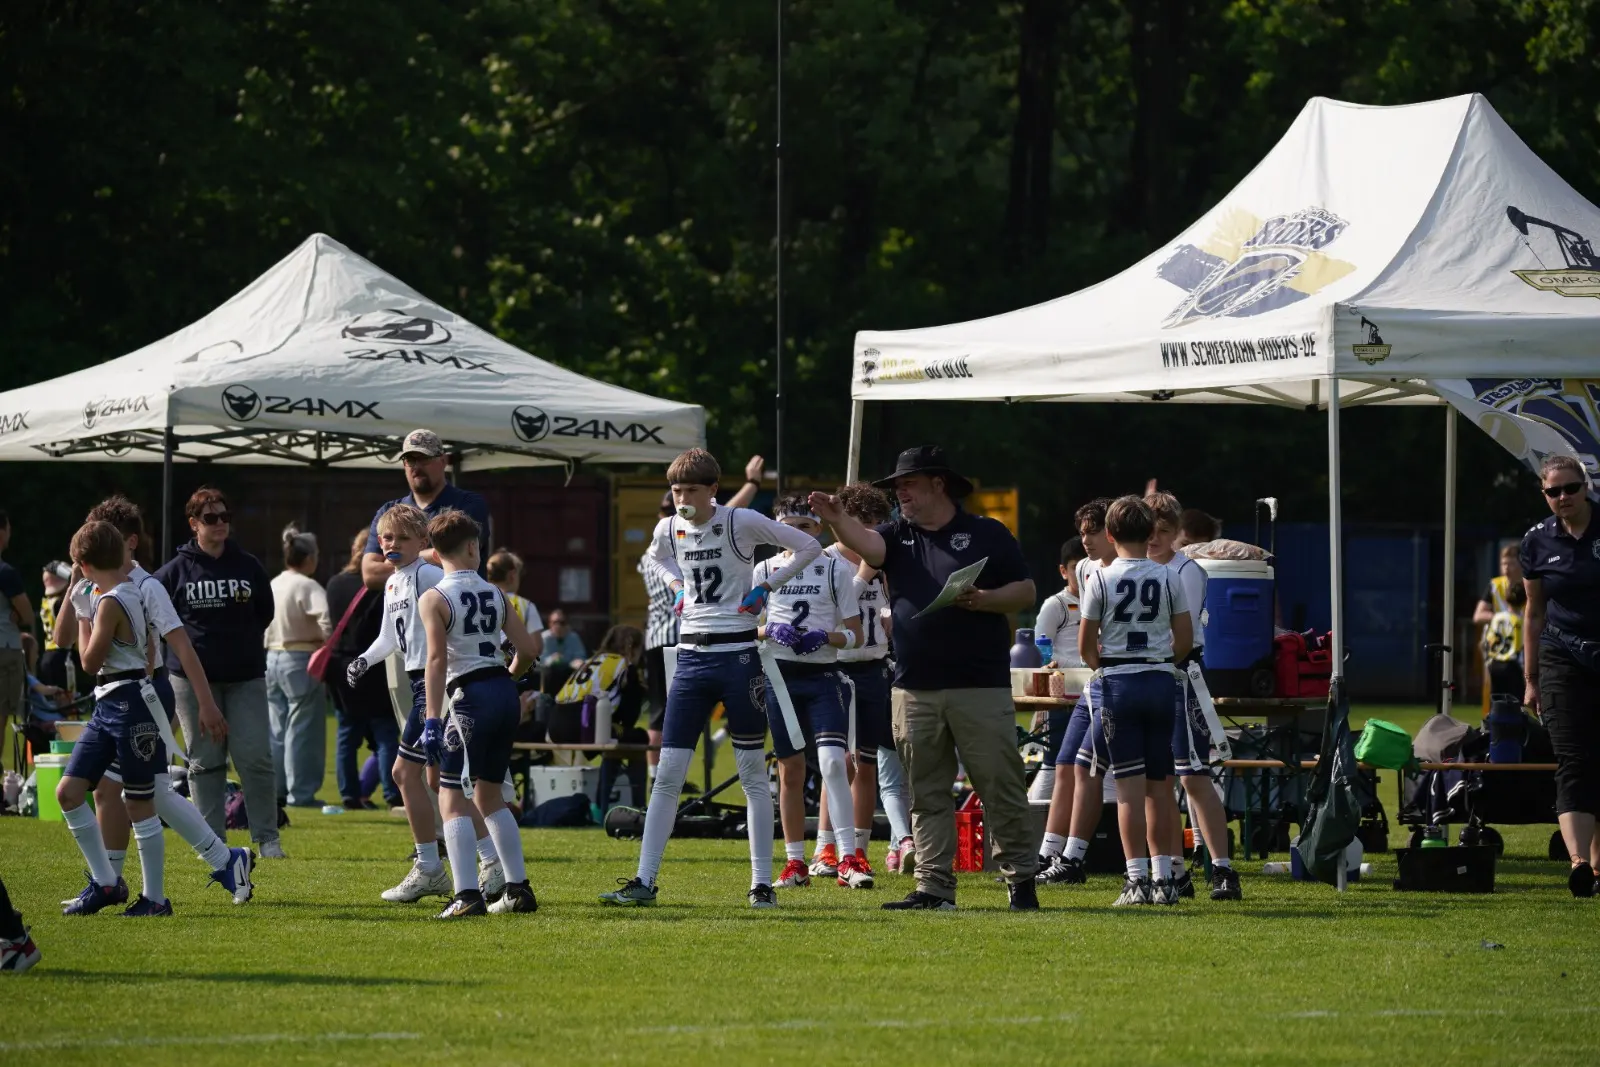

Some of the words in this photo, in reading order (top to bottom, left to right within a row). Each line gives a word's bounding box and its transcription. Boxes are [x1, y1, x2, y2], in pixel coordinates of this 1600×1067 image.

[344, 349, 505, 376] 24MX
[265, 396, 384, 420] 24MX
[552, 416, 665, 445] 24MX
[685, 547, 723, 561] RIDERS
[185, 579, 252, 601] RIDERS
[692, 564, 723, 604] 12
[779, 585, 821, 595] RIDERS
[460, 591, 498, 635] 25
[1113, 579, 1162, 623] 29
[791, 600, 809, 631] 2
